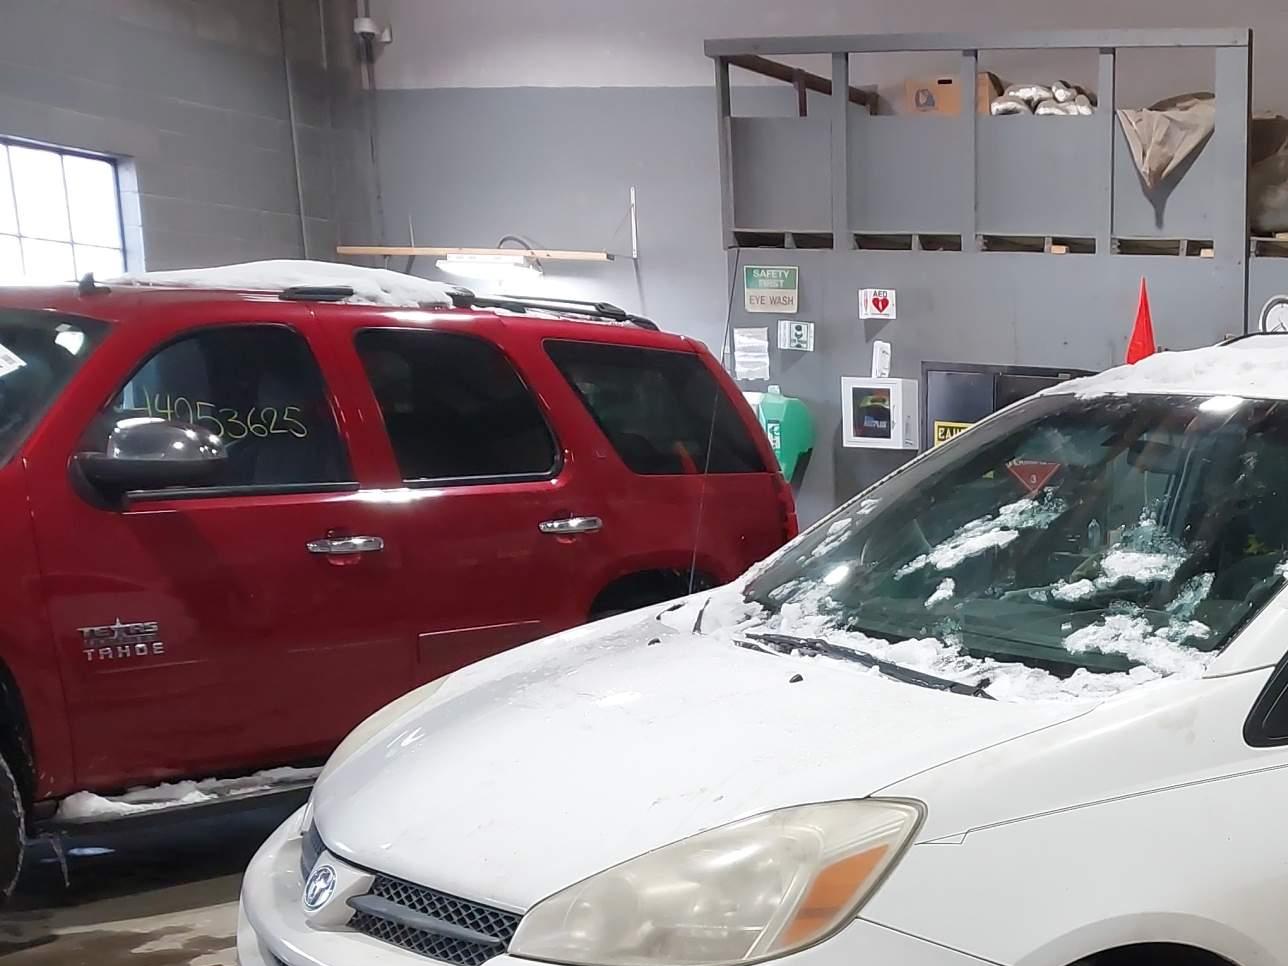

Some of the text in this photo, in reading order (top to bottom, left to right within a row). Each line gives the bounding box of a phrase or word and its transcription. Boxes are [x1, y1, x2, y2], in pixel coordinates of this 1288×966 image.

[752, 268, 790, 279] SAFETY
[749, 295, 794, 305] EYE WASH
[82, 641, 165, 661] TAHOE
